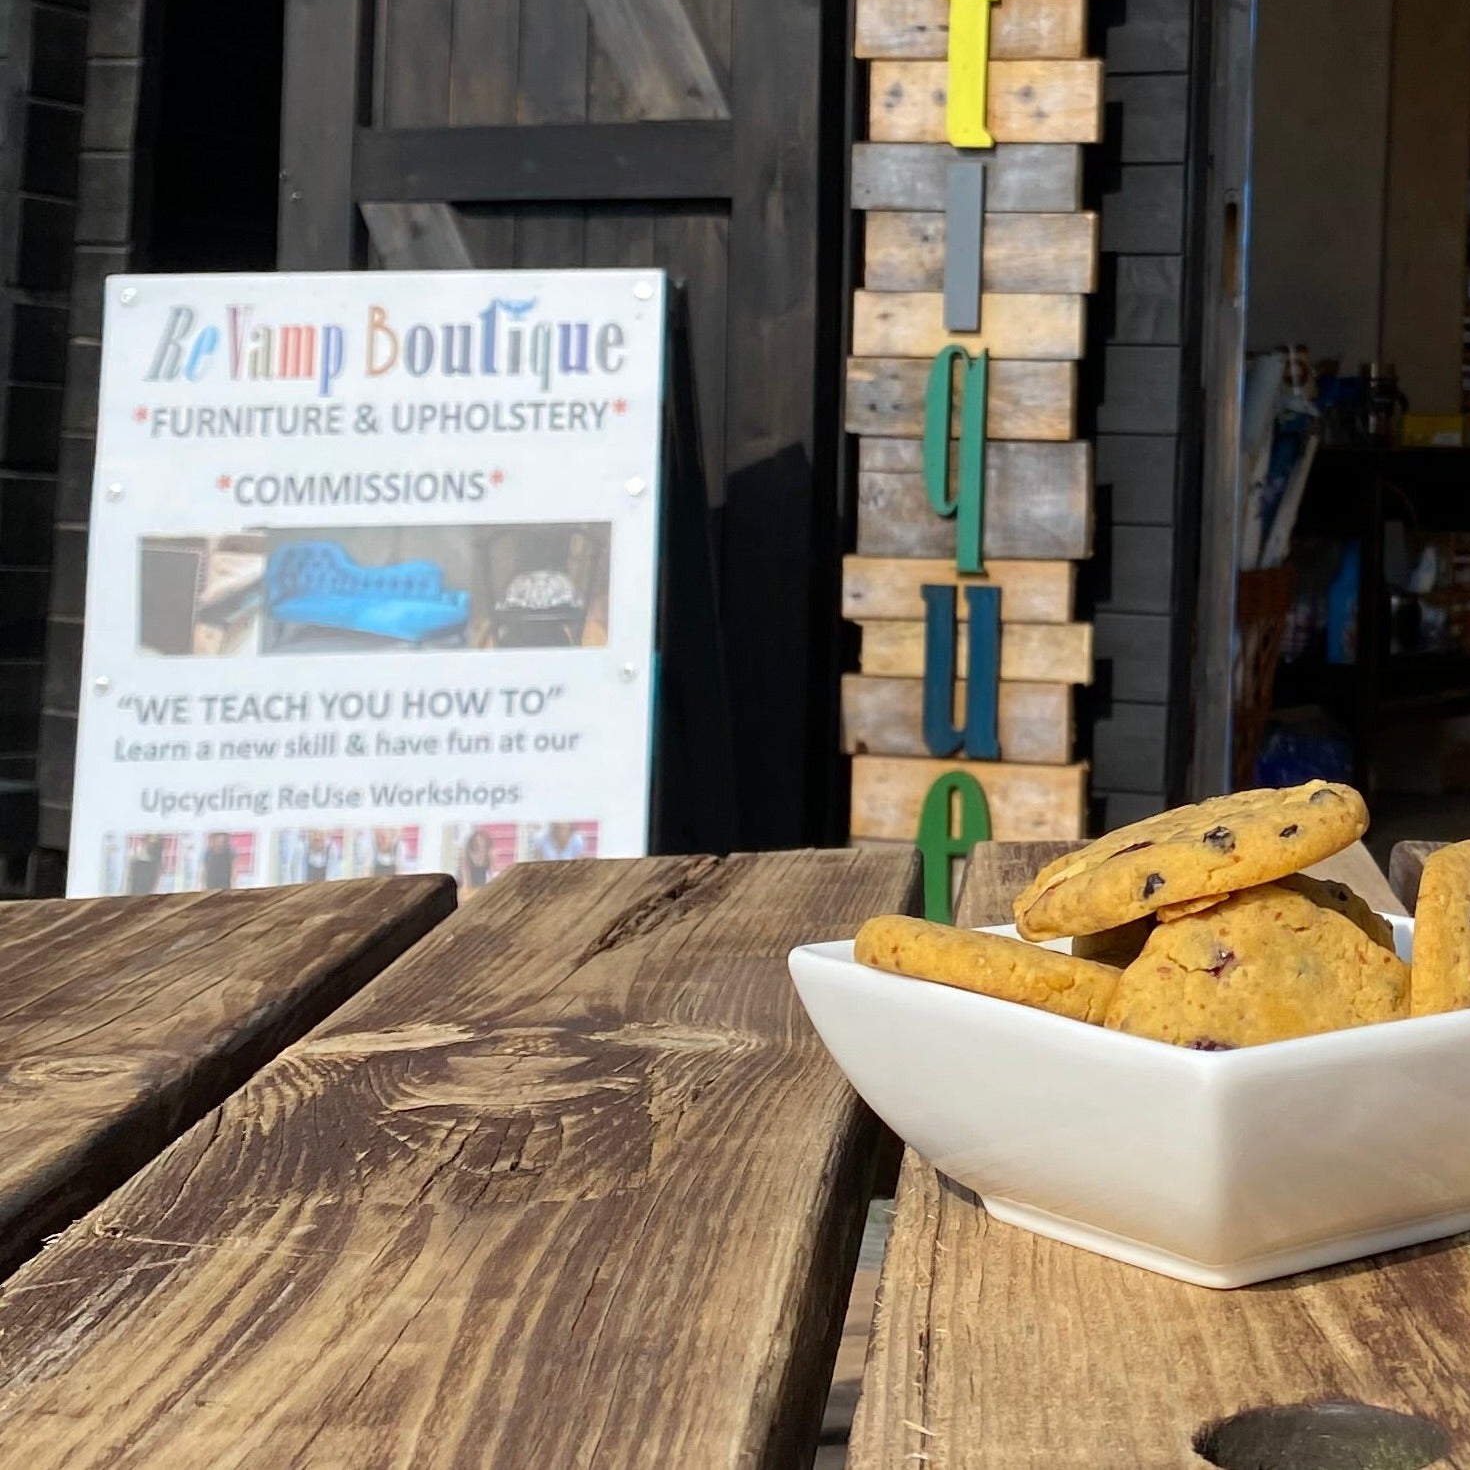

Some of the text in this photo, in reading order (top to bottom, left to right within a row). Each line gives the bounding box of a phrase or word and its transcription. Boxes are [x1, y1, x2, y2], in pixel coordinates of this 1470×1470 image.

[143, 296, 624, 398] ReVamp Boutique
[352, 403, 378, 435] &
[201, 692, 308, 724] TEACH
[320, 690, 391, 722] YOU
[402, 686, 491, 719] HOW
[114, 729, 579, 762] Learn a new skill & have fun at our
[140, 778, 522, 816] Upcycling ReUse Workshops
